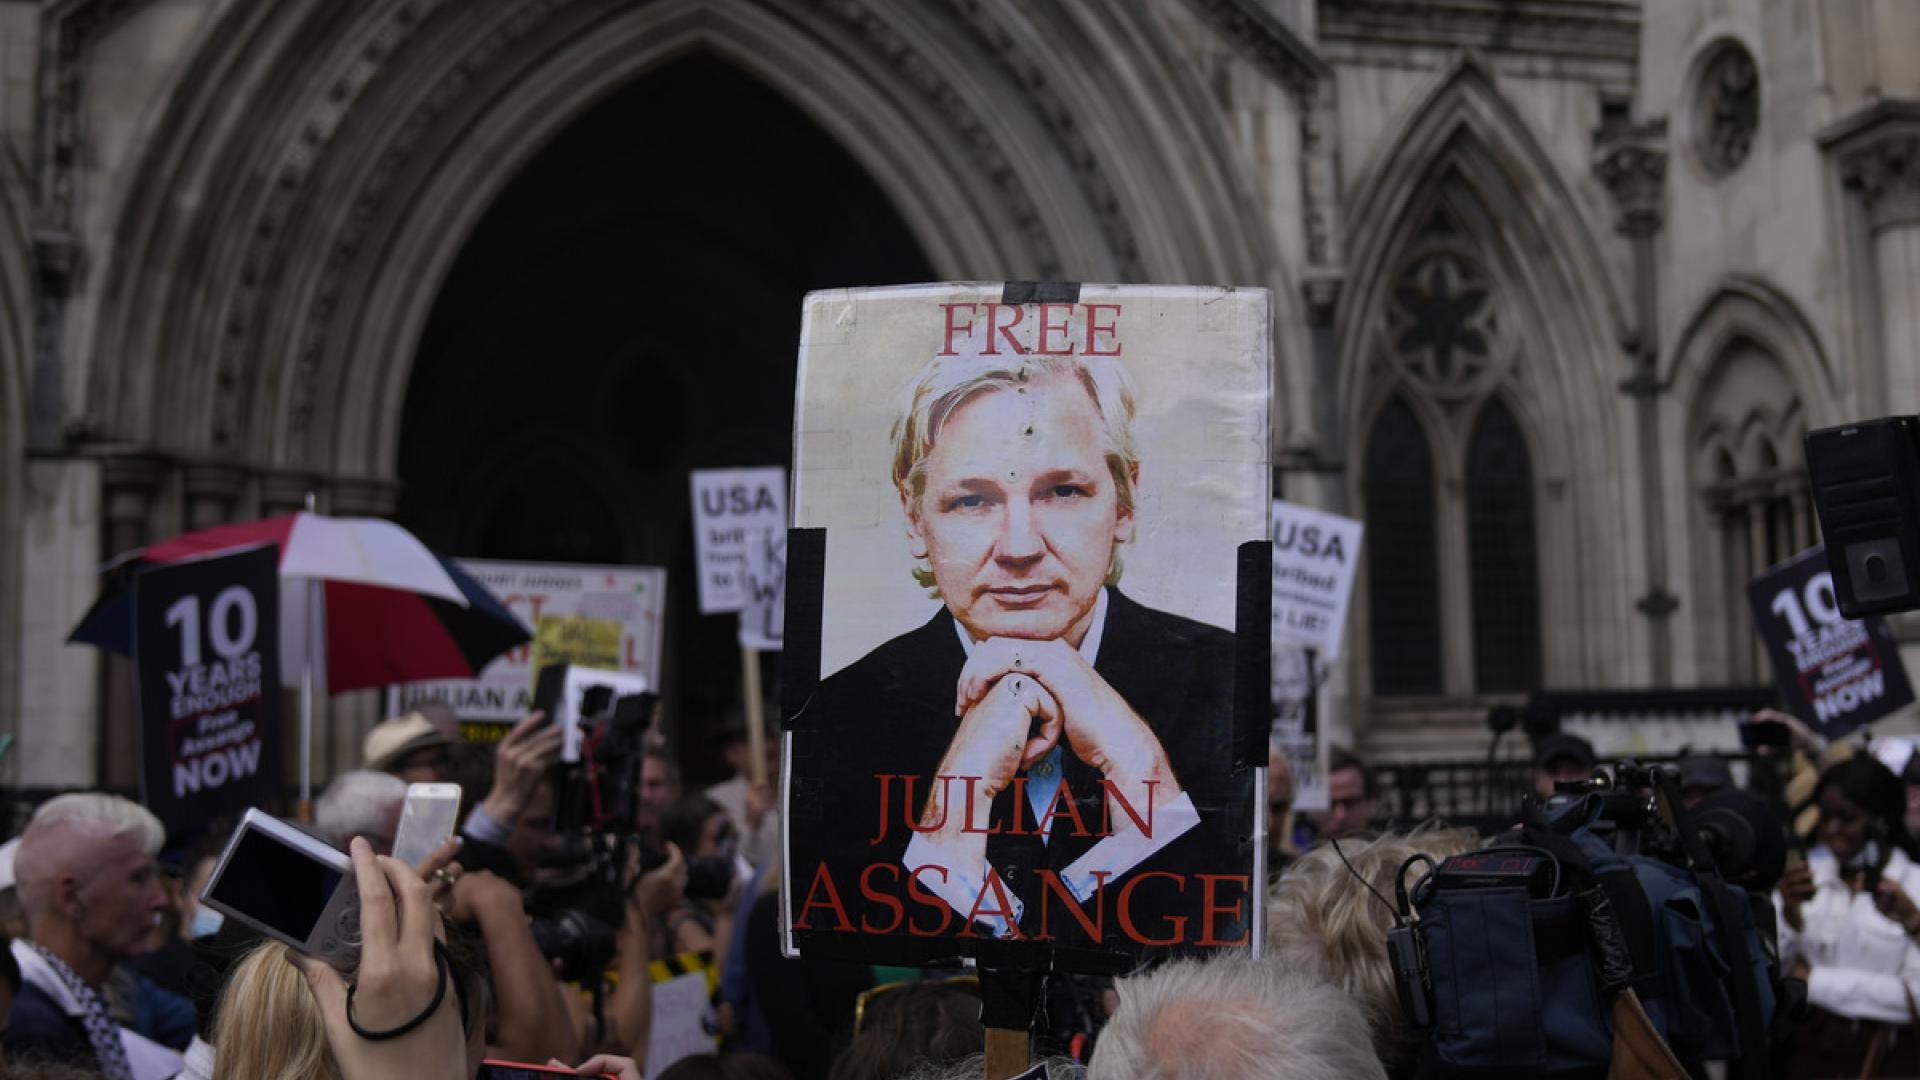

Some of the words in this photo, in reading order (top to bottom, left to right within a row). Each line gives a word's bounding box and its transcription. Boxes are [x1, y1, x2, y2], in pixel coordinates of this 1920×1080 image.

[937, 302, 1122, 357] FREE
[702, 485, 777, 517] USA
[1273, 520, 1345, 566] USA
[165, 585, 258, 667] 10
[1771, 571, 1841, 642] 10
[164, 652, 262, 698] YEARS
[1813, 668, 1884, 723] NOW
[173, 738, 262, 798] NOW
[870, 773, 1161, 845] JULIAN
[791, 860, 1251, 947] ASSANGE
